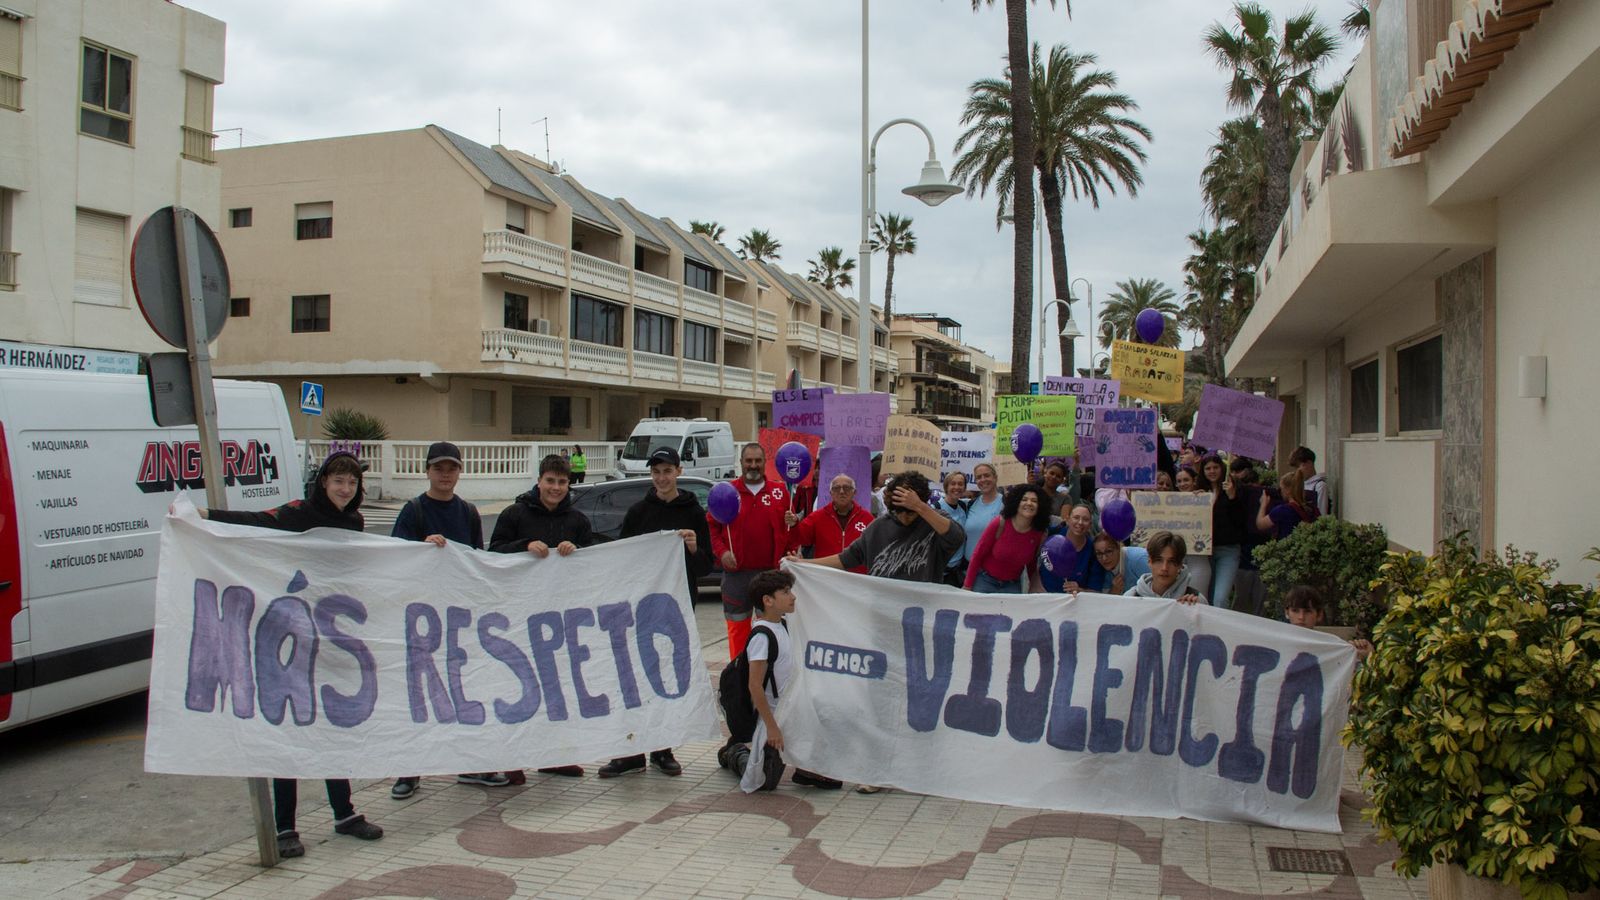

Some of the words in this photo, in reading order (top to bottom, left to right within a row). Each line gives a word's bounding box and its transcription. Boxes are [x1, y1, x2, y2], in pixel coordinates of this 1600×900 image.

[10, 349, 86, 371] HERNÁNDEZ
[1046, 380, 1084, 393] DENUNCIA
[1093, 383, 1107, 394] LA
[1002, 396, 1035, 409] TRUMP
[830, 416, 873, 428] LIBRE
[999, 408, 1032, 424] PUTIN
[32, 440, 90, 452] MAQUINARIA
[136, 439, 262, 493] ANGRA
[37, 469, 72, 480] MENAJE
[242, 486, 281, 499] HOSTELERIA
[40, 497, 77, 509] VAJILLAS
[44, 525, 91, 540] VESTUARIO
[93, 524, 103, 534] DE
[105, 517, 149, 533] HOSTELERÍA
[49, 554, 96, 569] ARTÍCULOS
[98, 552, 108, 563] DE
[110, 548, 144, 561] NAVIDAD
[185, 569, 378, 728] MÁS
[405, 592, 692, 726] RESPETO
[809, 645, 875, 675] MENOS
[902, 606, 1324, 800] VIOLENCIA
